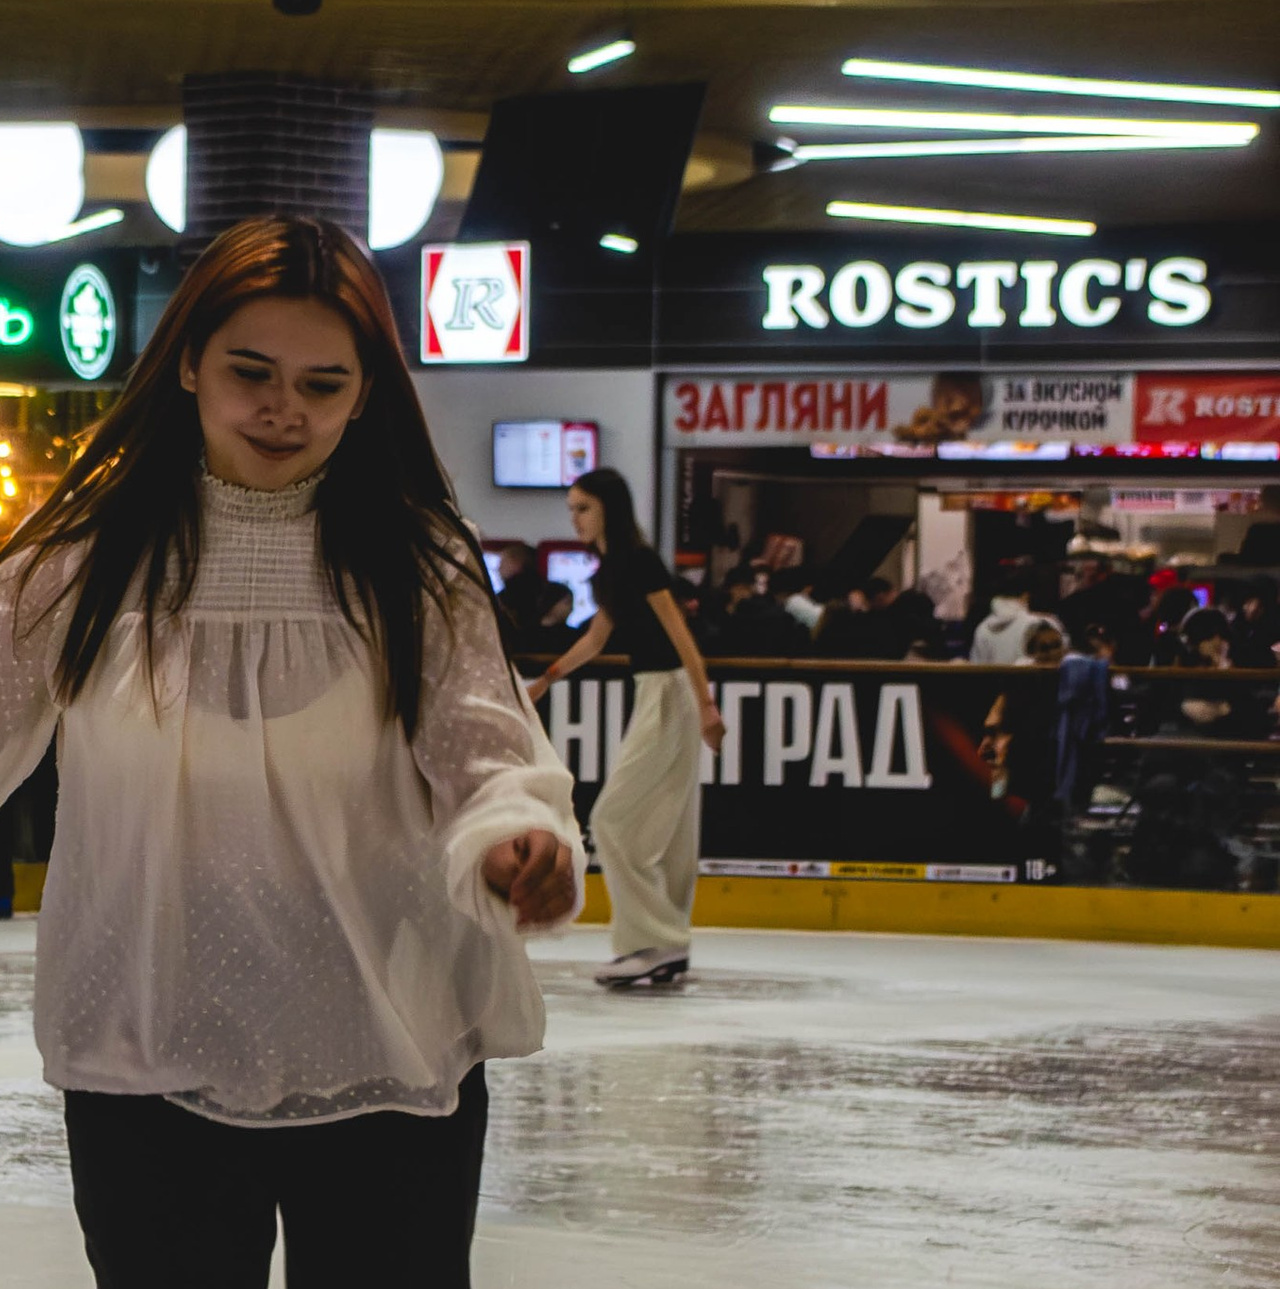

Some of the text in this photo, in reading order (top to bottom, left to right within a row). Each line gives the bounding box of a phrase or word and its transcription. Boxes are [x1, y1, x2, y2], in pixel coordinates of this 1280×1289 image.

[444, 277, 505, 331] R
[761, 257, 1212, 330] ROSTIC'S
[675, 381, 889, 433] ЗАГЛЯНИ
[1195, 395, 1280, 418] ROST
